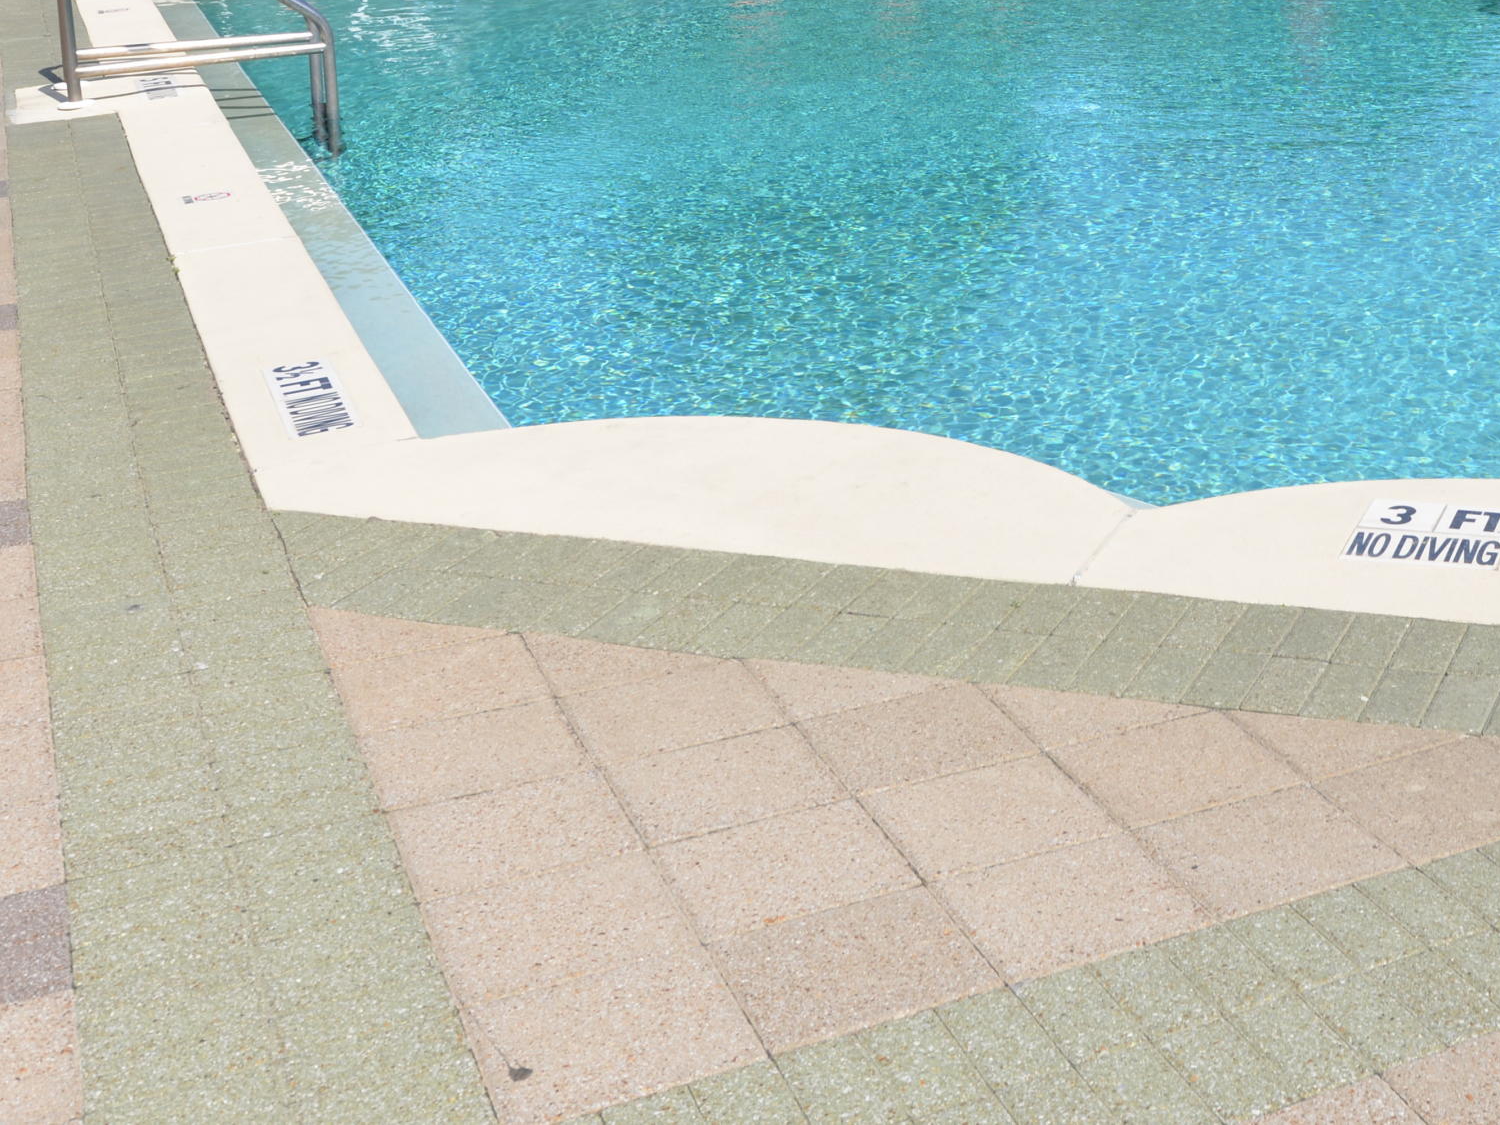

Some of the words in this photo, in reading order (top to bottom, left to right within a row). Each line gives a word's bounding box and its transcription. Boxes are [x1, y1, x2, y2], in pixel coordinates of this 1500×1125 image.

[279, 376, 333, 396] FT
[1380, 505, 1417, 525] 3
[1345, 531, 1391, 558] NO
[1391, 534, 1500, 566] DIVING
